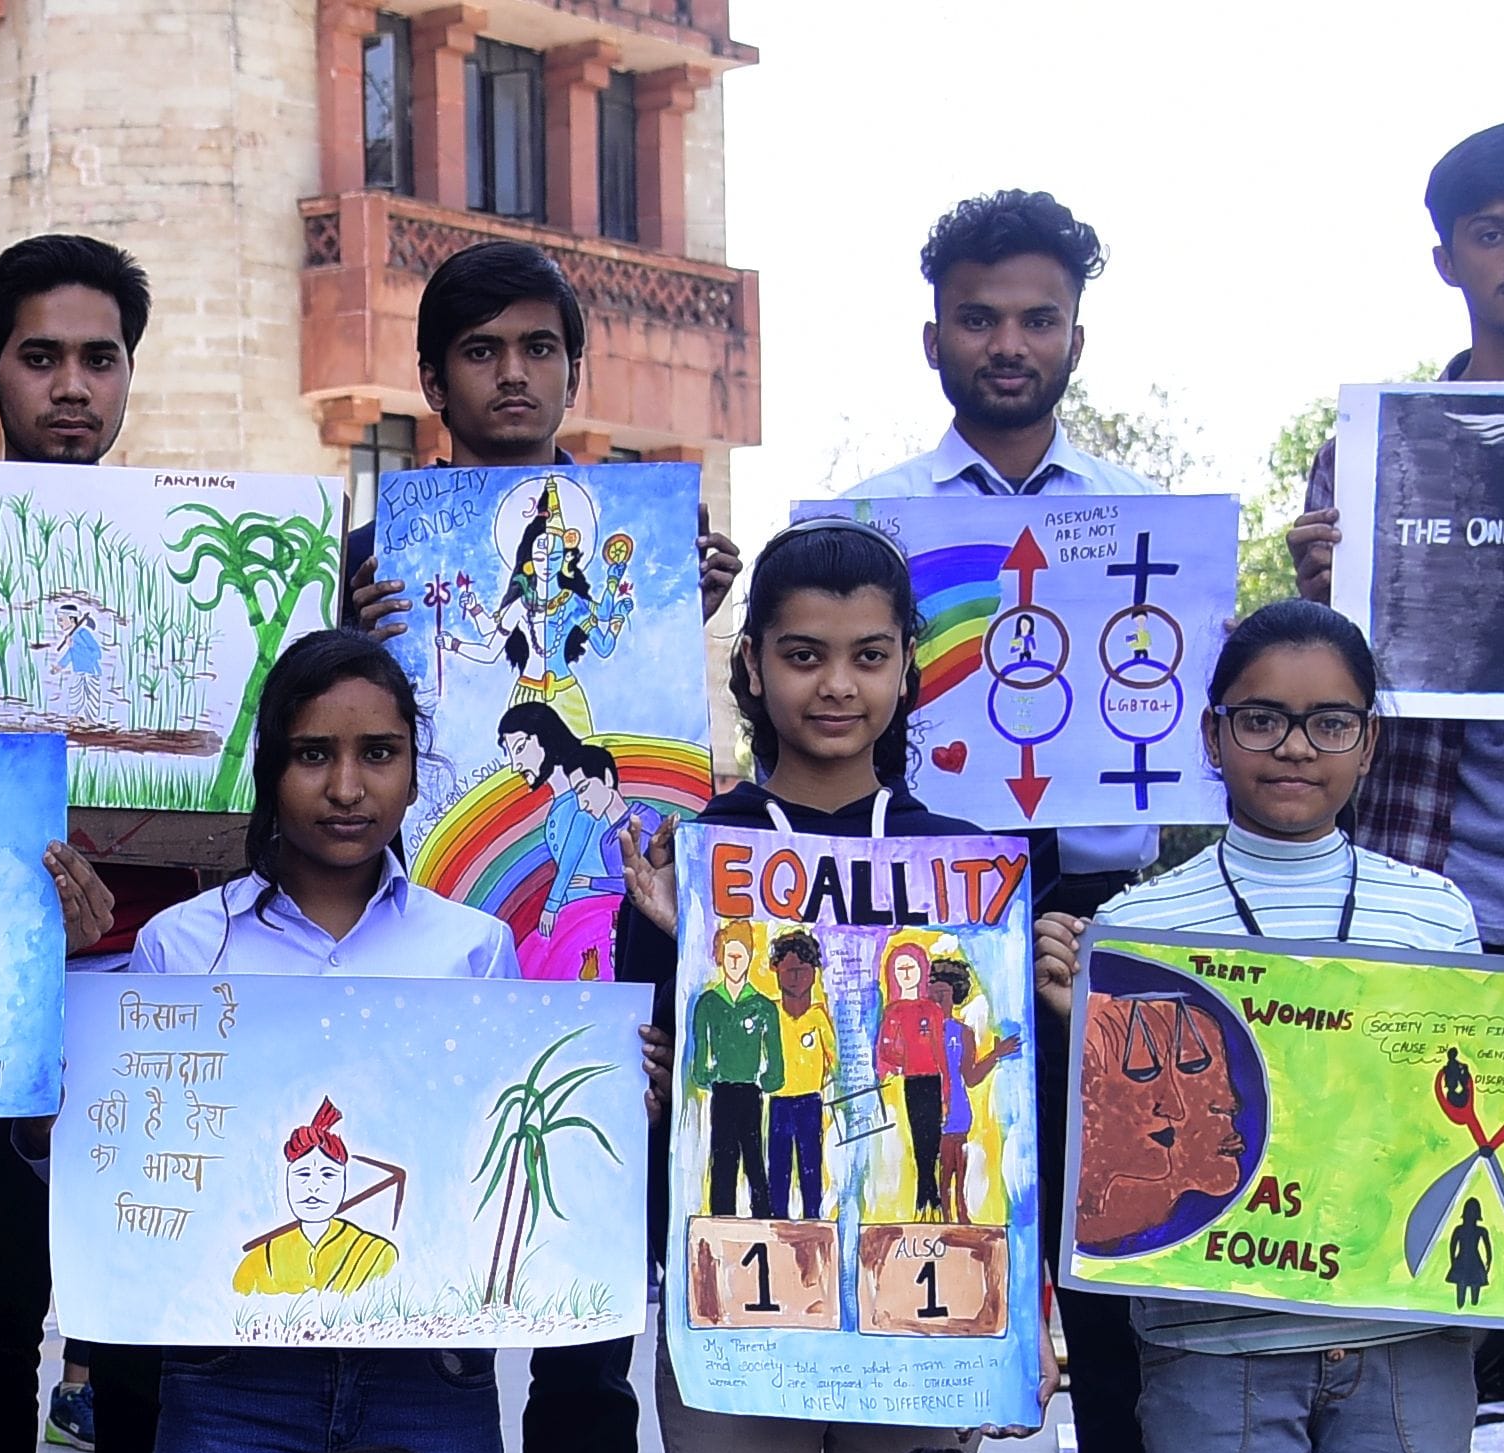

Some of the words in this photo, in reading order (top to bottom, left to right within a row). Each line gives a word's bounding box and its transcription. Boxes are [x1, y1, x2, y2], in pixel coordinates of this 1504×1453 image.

[153, 473, 238, 491] FARMING
[381, 469, 490, 519] EQULITY
[383, 499, 482, 555] GENDER
[1045, 505, 1119, 528] ASEXUAL'S
[1395, 517, 1452, 546] THE
[1054, 526, 1083, 542] ARE
[1087, 524, 1116, 538] NOT
[1059, 542, 1118, 563] BROKEN
[1107, 698, 1173, 714] LGBTQ+
[711, 842, 1028, 926] EQALLITY
[1188, 954, 1267, 986] TREAT
[118, 989, 203, 1033] किसान
[212, 982, 239, 1038] है
[1241, 996, 1355, 1033] WOMENS
[1369, 1019, 1422, 1034] SOCIETY
[1432, 1023, 1446, 1034] IS
[1453, 1024, 1477, 1037] THE
[1392, 1042, 1427, 1054] CAUSE
[88, 1089, 130, 1136] वही
[144, 1086, 167, 1140] है
[184, 1089, 238, 1141] देश
[90, 1143, 120, 1173] का
[142, 1152, 224, 1192] भाग्य
[1245, 1175, 1302, 1219] AS
[895, 1236, 948, 1261] ALSO
[1204, 1230, 1342, 1281] EQUALS
[742, 1242, 781, 1313] 1
[916, 1260, 950, 1319] 1
[703, 1338, 725, 1360] My
[803, 1396, 847, 1411] KNEW
[859, 1397, 878, 1410] NO
[885, 1395, 966, 1412] DIFFERENCE
